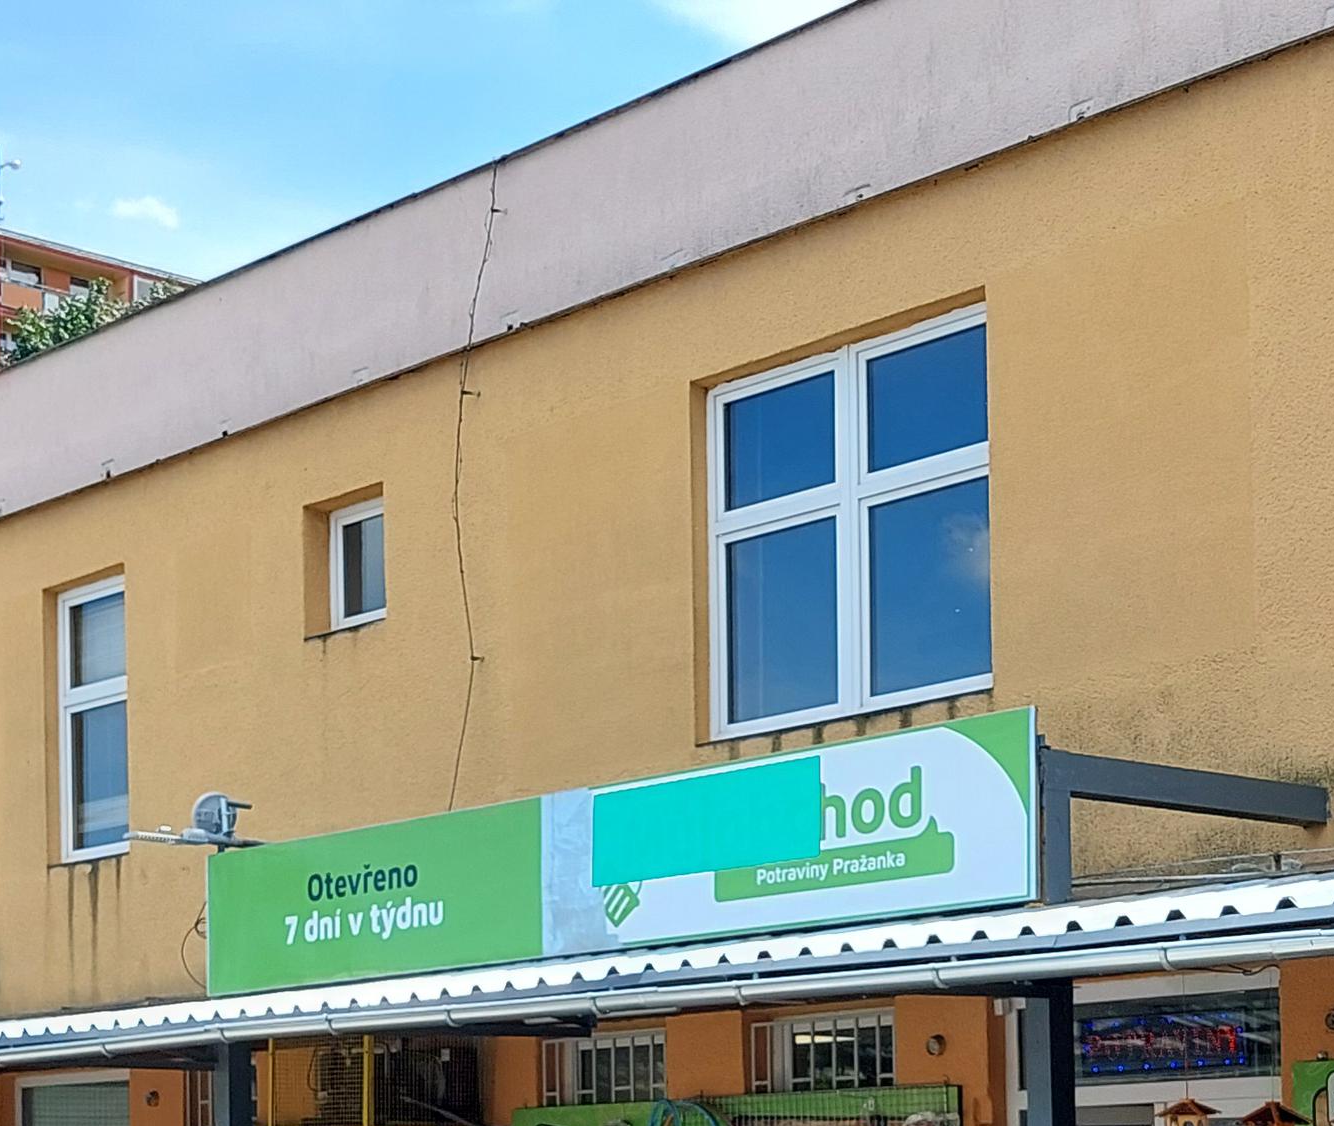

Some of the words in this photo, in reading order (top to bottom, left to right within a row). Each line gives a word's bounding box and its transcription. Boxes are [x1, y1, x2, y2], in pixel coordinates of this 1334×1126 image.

[307, 864, 419, 902] Otevřeno
[755, 861, 829, 886] Potraviny
[832, 850, 906, 876] Pražanka
[284, 915, 299, 945] 7
[304, 908, 342, 943] dní
[347, 911, 364, 936] v
[369, 896, 444, 940] týdnu
